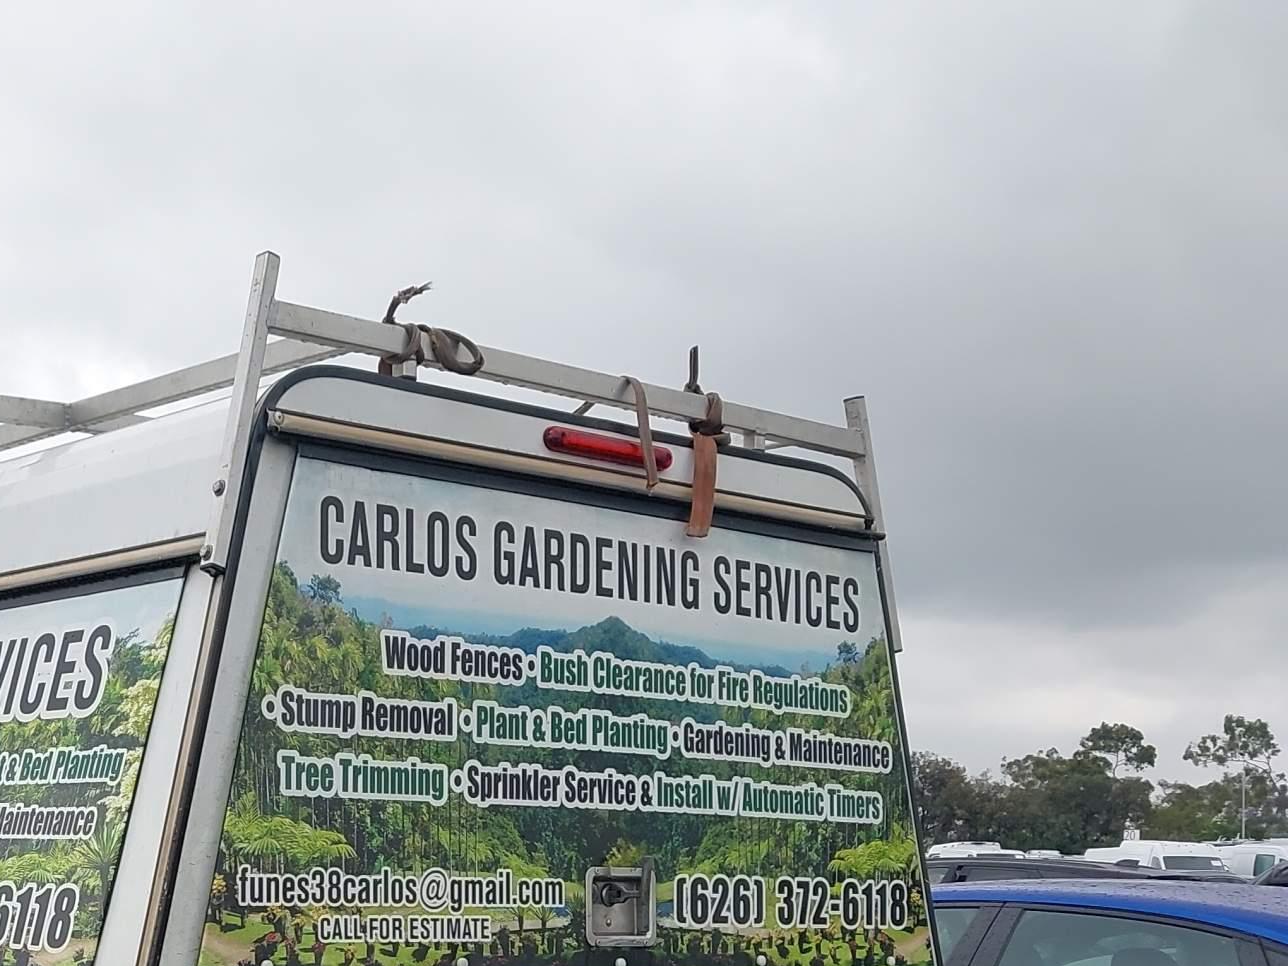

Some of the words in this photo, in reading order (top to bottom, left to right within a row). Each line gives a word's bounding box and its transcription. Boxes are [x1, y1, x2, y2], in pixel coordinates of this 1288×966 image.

[319, 495, 477, 581] CARLOS
[493, 520, 700, 610] GARDENING
[713, 555, 860, 633] SERVICES
[384, 635, 446, 674] Wood
[450, 641, 523, 681] Fences
[540, 650, 589, 687] Bush
[593, 656, 687, 696] Clearance
[689, 667, 715, 698] for
[718, 670, 749, 703] Fire
[753, 674, 849, 714] Regulations
[280, 690, 356, 733] Stump
[361, 696, 454, 736] Removal
[476, 705, 528, 741] Plant
[532, 714, 546, 742] &
[550, 711, 588, 745] Bed
[592, 714, 669, 753] Planting
[683, 722, 771, 762] Gardening
[774, 735, 786, 760] &
[789, 731, 890, 769] Maintenance
[6, 757, 18, 782] &
[19, 750, 54, 782] Bed
[53, 748, 125, 782] Planting
[281, 755, 335, 792] Tree
[339, 758, 445, 801] Trimming
[467, 764, 561, 801] Sprinkler
[564, 770, 636, 805] Service
[640, 780, 653, 807] &
[657, 776, 713, 810] Install
[716, 780, 739, 811] w/
[743, 781, 824, 817] Automatic
[827, 788, 881, 820] Timers
[238, 866, 563, 913] funes38carlos@gmail.com
[675, 879, 765, 926] (626)
[777, 879, 908, 928] 372-6118
[319, 918, 363, 941] CALL
[369, 918, 403, 941] FOR
[410, 917, 491, 941] ESTIMATE
